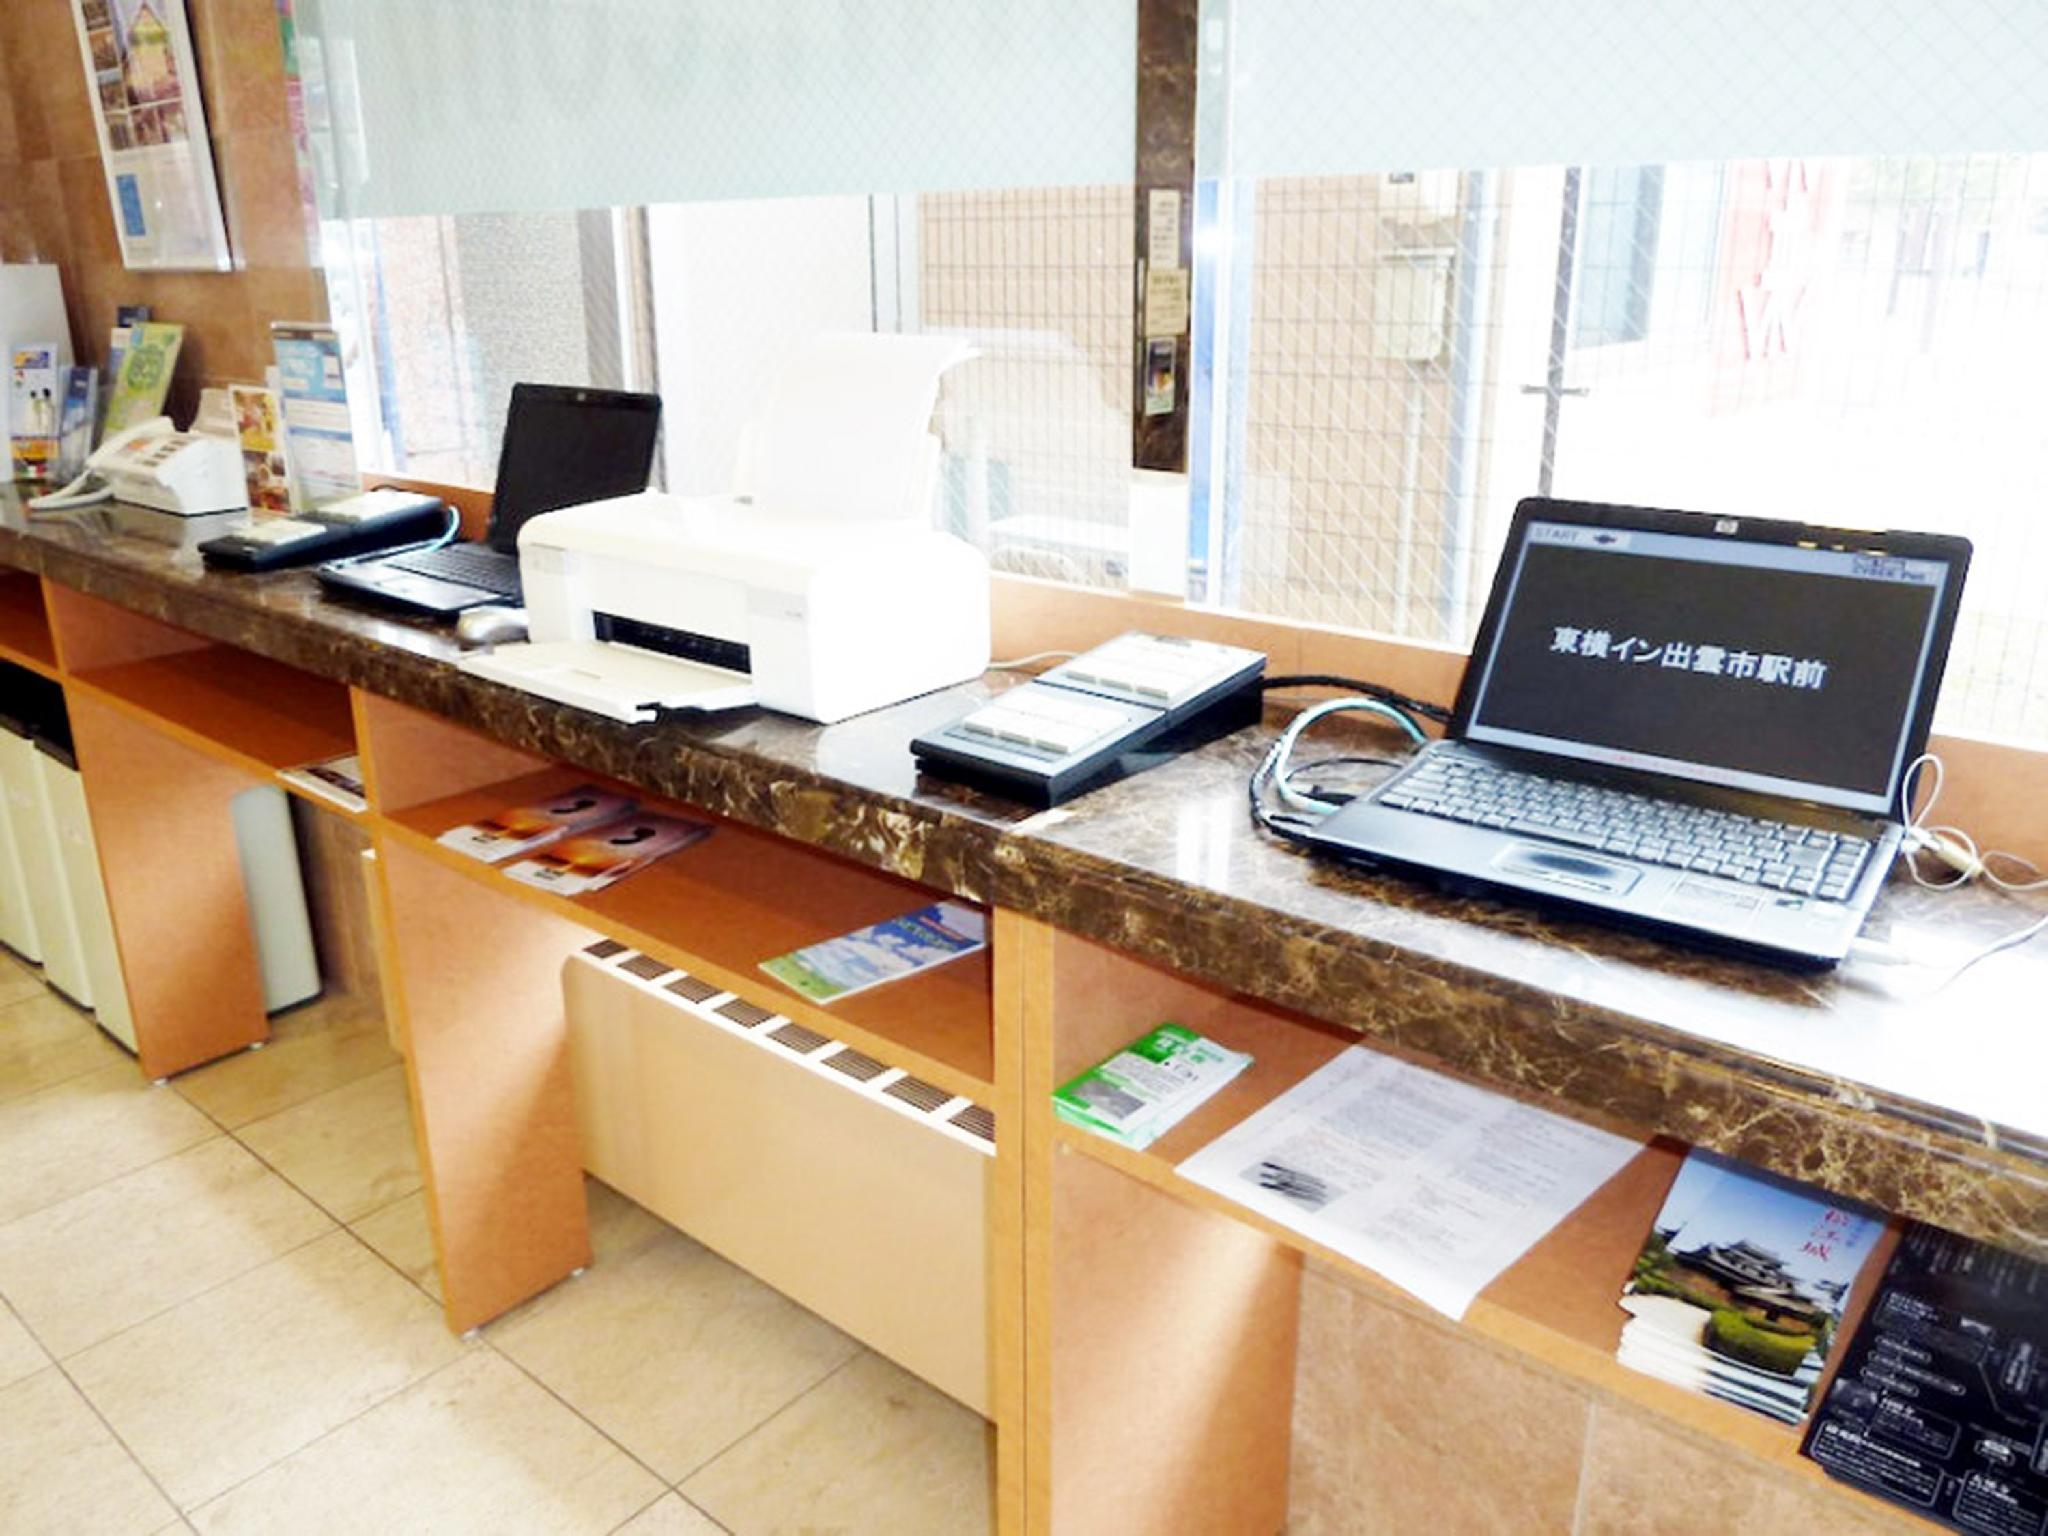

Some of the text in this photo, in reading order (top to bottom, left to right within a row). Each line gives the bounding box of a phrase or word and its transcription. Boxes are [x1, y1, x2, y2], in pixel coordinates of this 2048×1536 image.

[1535, 526, 1579, 541] START
[1550, 626, 1828, 690] 東横イン出雲市駅前
